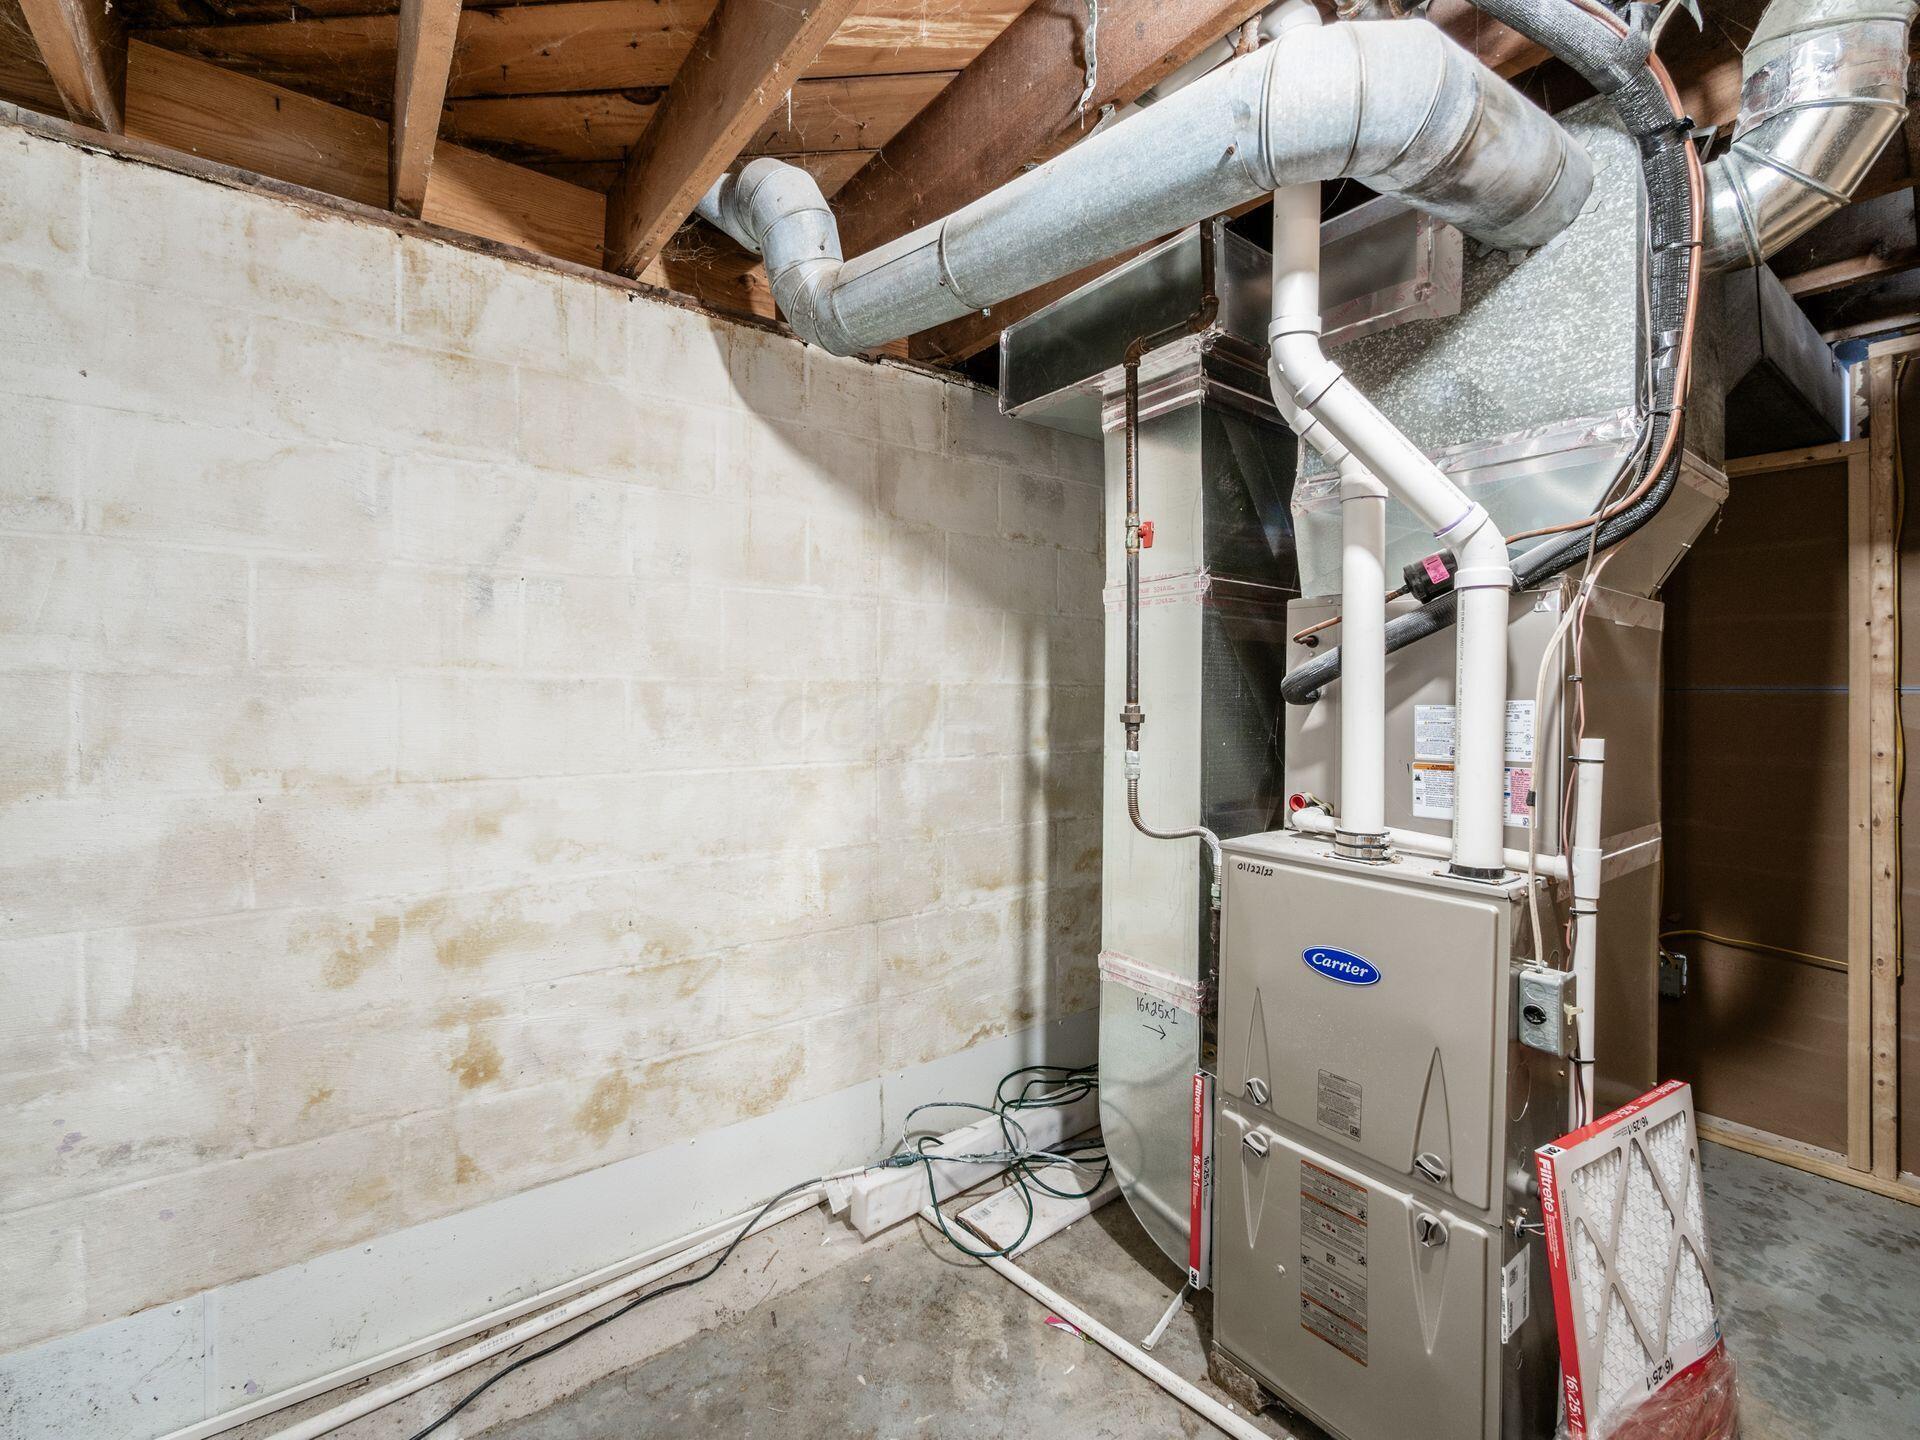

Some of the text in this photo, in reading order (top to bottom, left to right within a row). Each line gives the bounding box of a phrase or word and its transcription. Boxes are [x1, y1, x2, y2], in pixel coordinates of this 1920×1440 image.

[1237, 862, 1273, 877] 01/22/22
[1312, 952, 1369, 977] Carrier
[1538, 1157, 1555, 1212] Filtrete
[1566, 1374, 1583, 1429] 16x25x1
